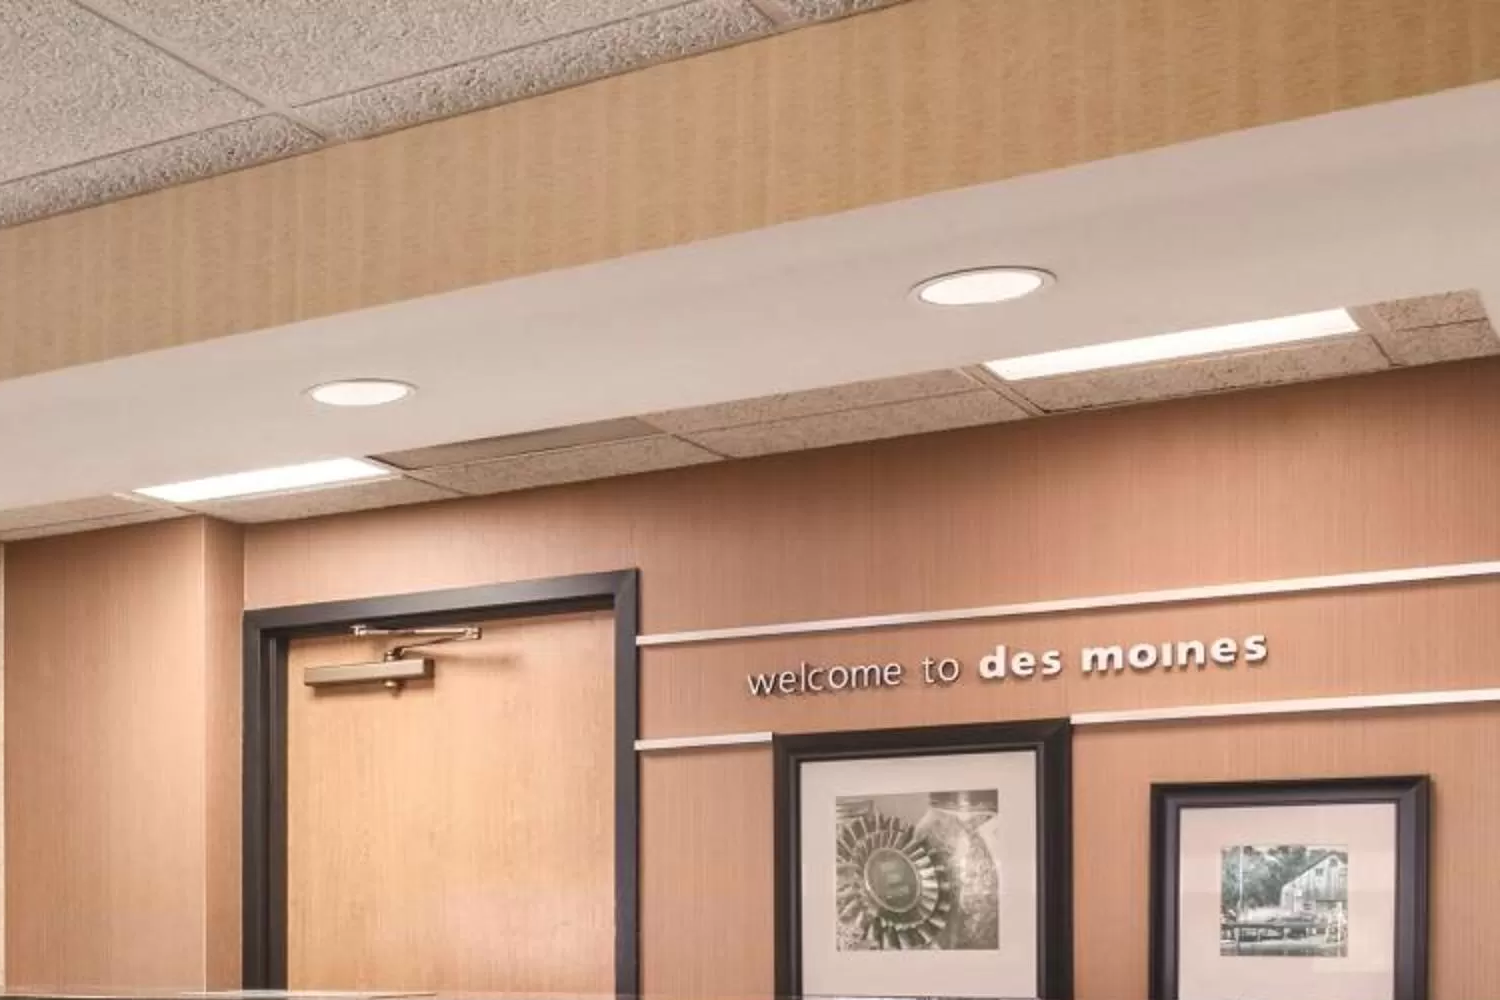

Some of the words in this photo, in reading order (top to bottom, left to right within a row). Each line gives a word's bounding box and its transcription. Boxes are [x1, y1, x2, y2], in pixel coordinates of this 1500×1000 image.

[747, 660, 903, 697] welcome
[921, 654, 960, 685] to
[978, 644, 1063, 680] des
